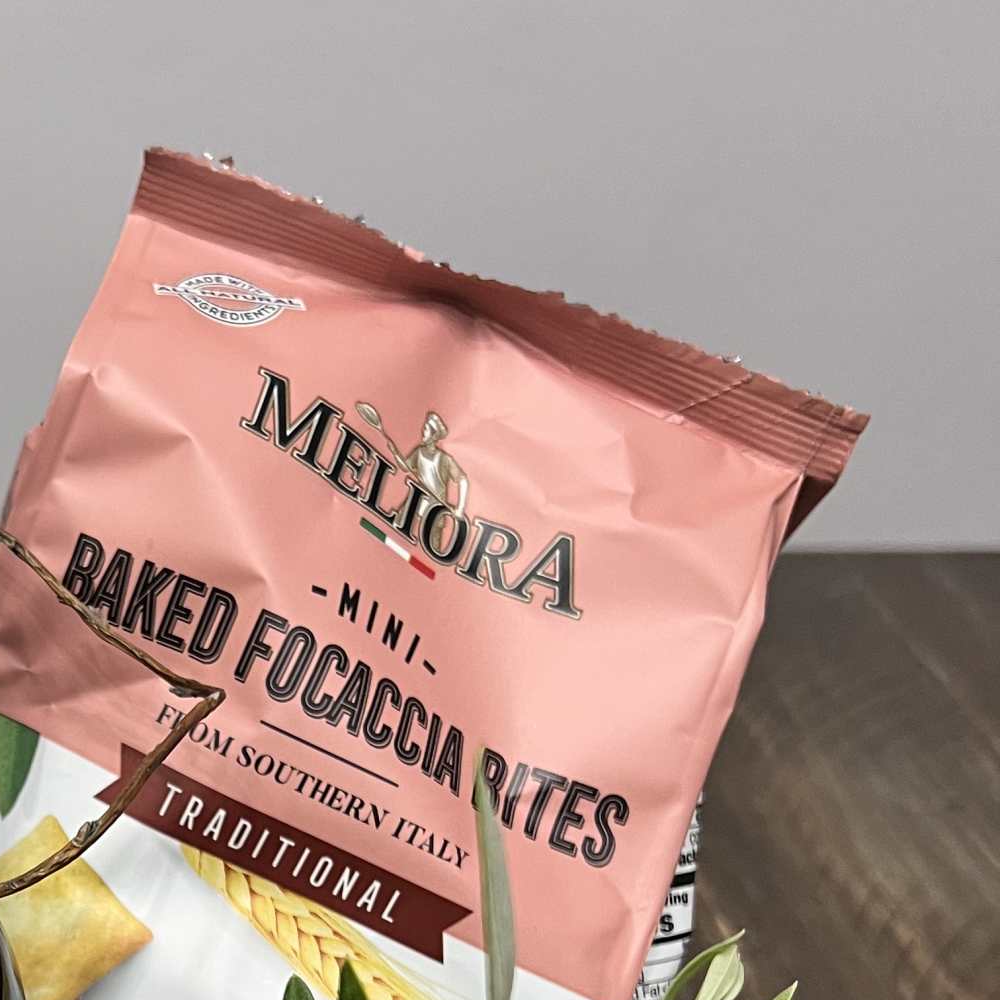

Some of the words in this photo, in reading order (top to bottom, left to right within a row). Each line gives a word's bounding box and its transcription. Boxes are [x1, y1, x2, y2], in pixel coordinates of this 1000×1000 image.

[239, 366, 583, 621] MELIORA
[62, 533, 239, 664] BAKED
[233, 608, 465, 798] FOCACCIA
[471, 748, 629, 869] BITES
[156, 782, 402, 923] TRADITIONAL
[236, 744, 389, 830] SOUTHERN
[390, 816, 471, 870] ITALY
